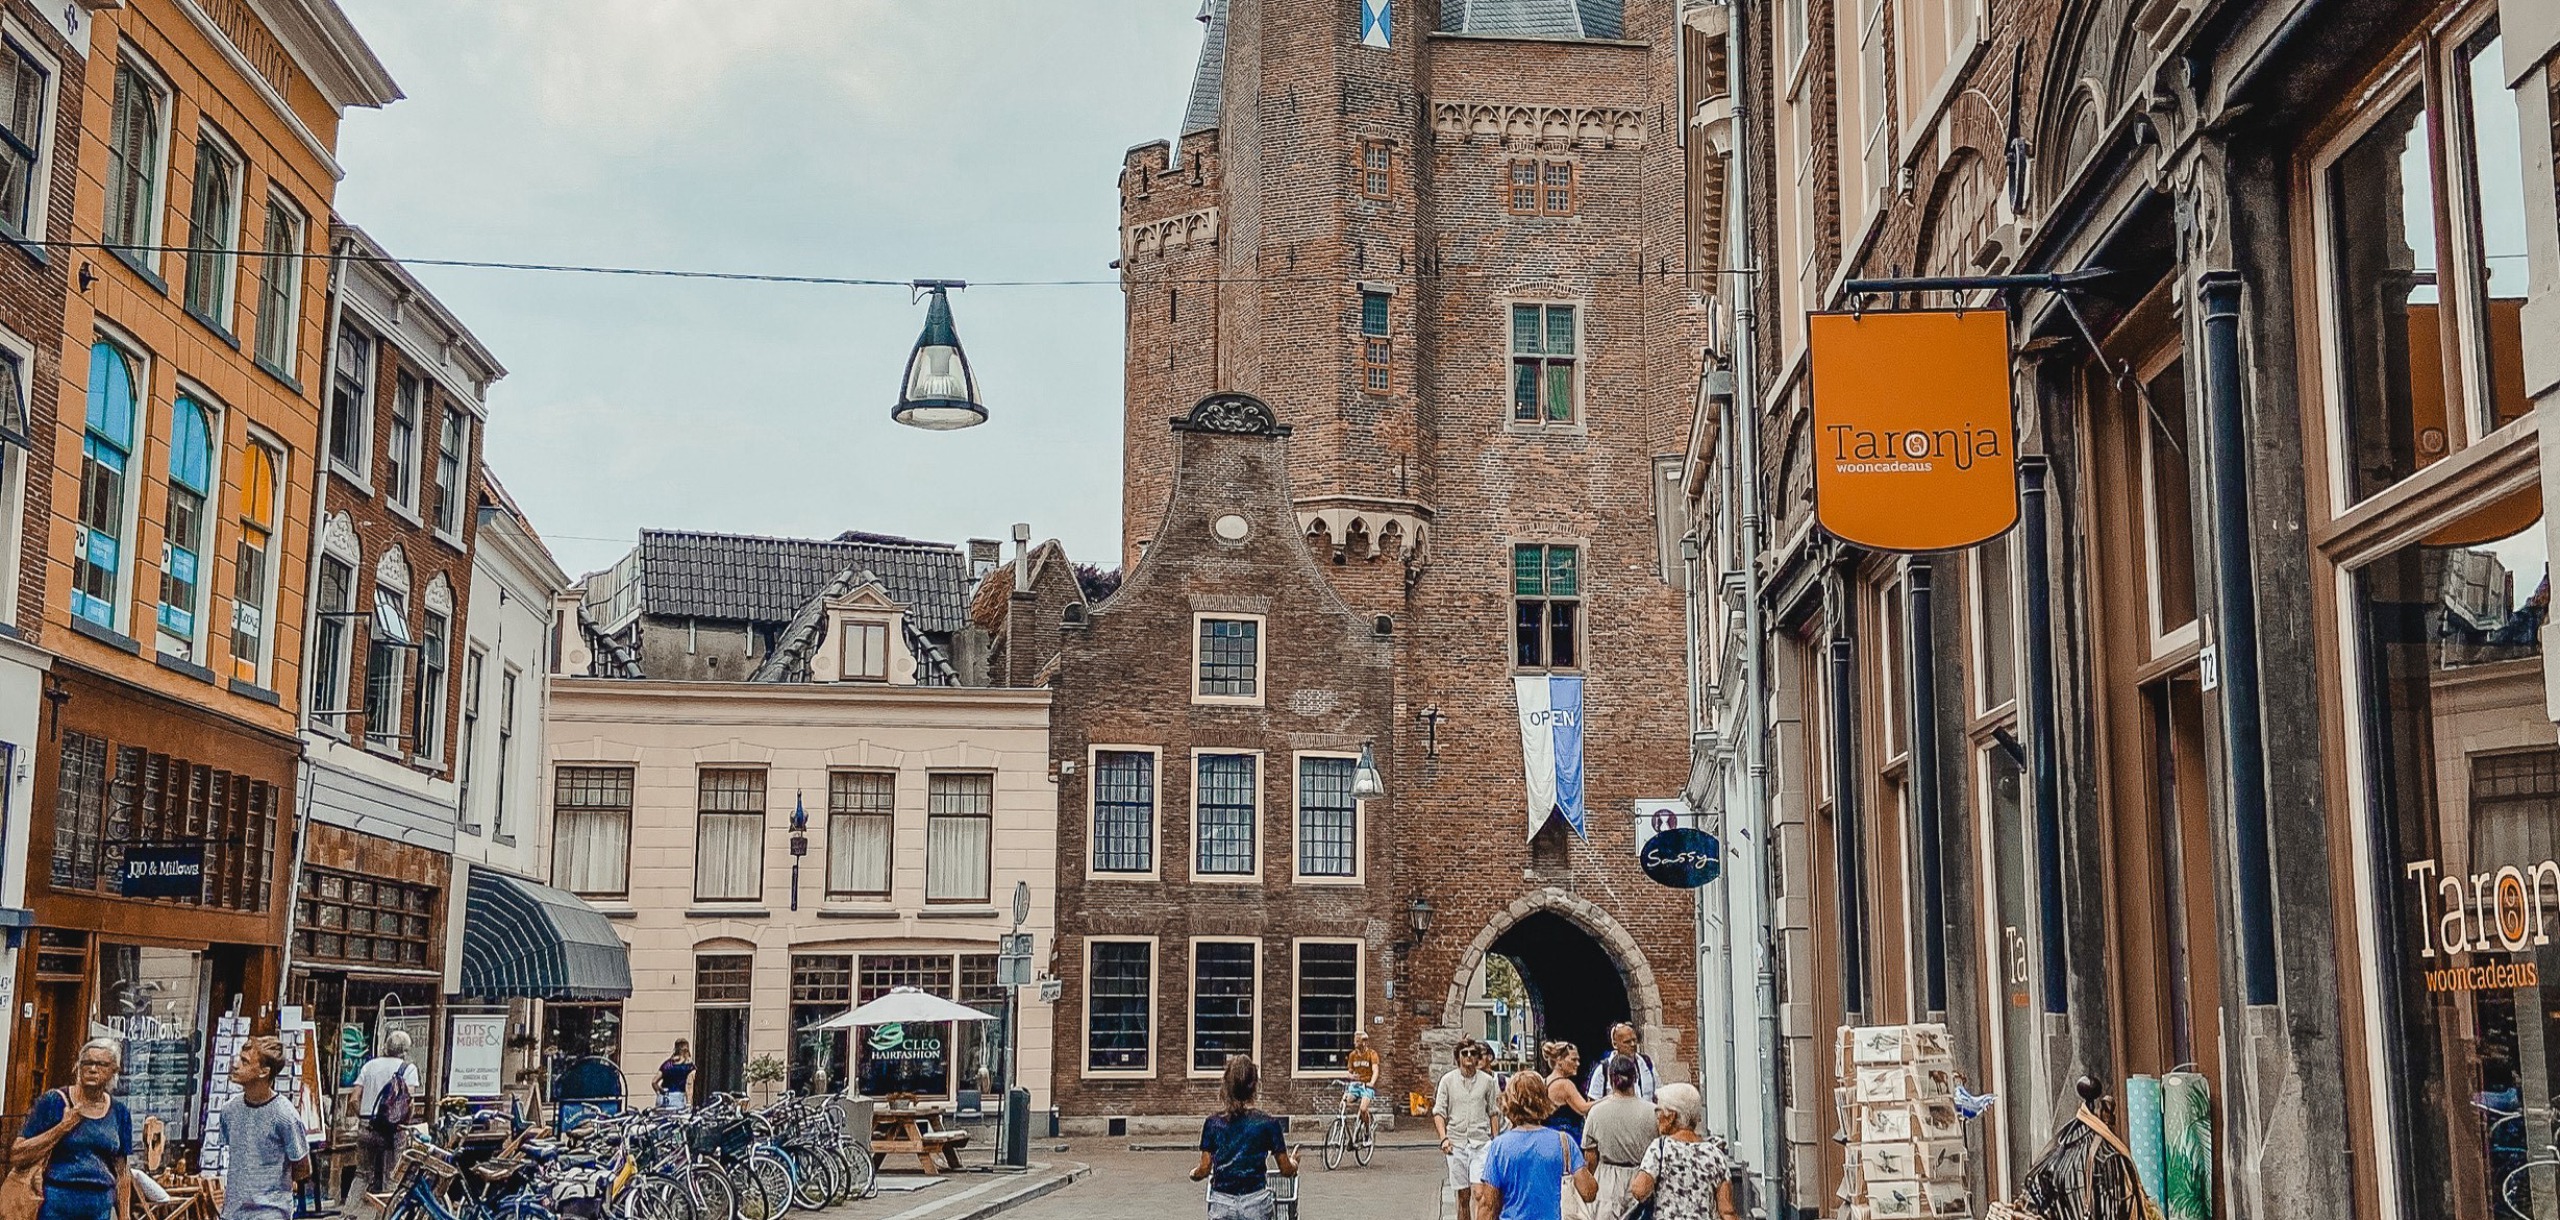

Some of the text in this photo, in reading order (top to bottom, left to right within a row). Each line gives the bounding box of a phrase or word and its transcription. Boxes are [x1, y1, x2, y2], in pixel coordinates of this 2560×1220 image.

[1826, 422, 2001, 470] Taronja
[1836, 461, 1932, 473] wooncadeaus
[2202, 653, 2214, 686] 72
[1530, 709, 1575, 727] OPEN
[148, 861, 158, 876] &
[159, 860, 200, 876] Millows
[2407, 859, 2560, 958] Taron
[2425, 958, 2538, 992] wooncadeaus
[456, 1036, 484, 1048] MORE
[457, 1024, 500, 1046] LOTS &
[902, 1039, 941, 1050] CLEO
[871, 1050, 941, 1060] HAIRFASHION
